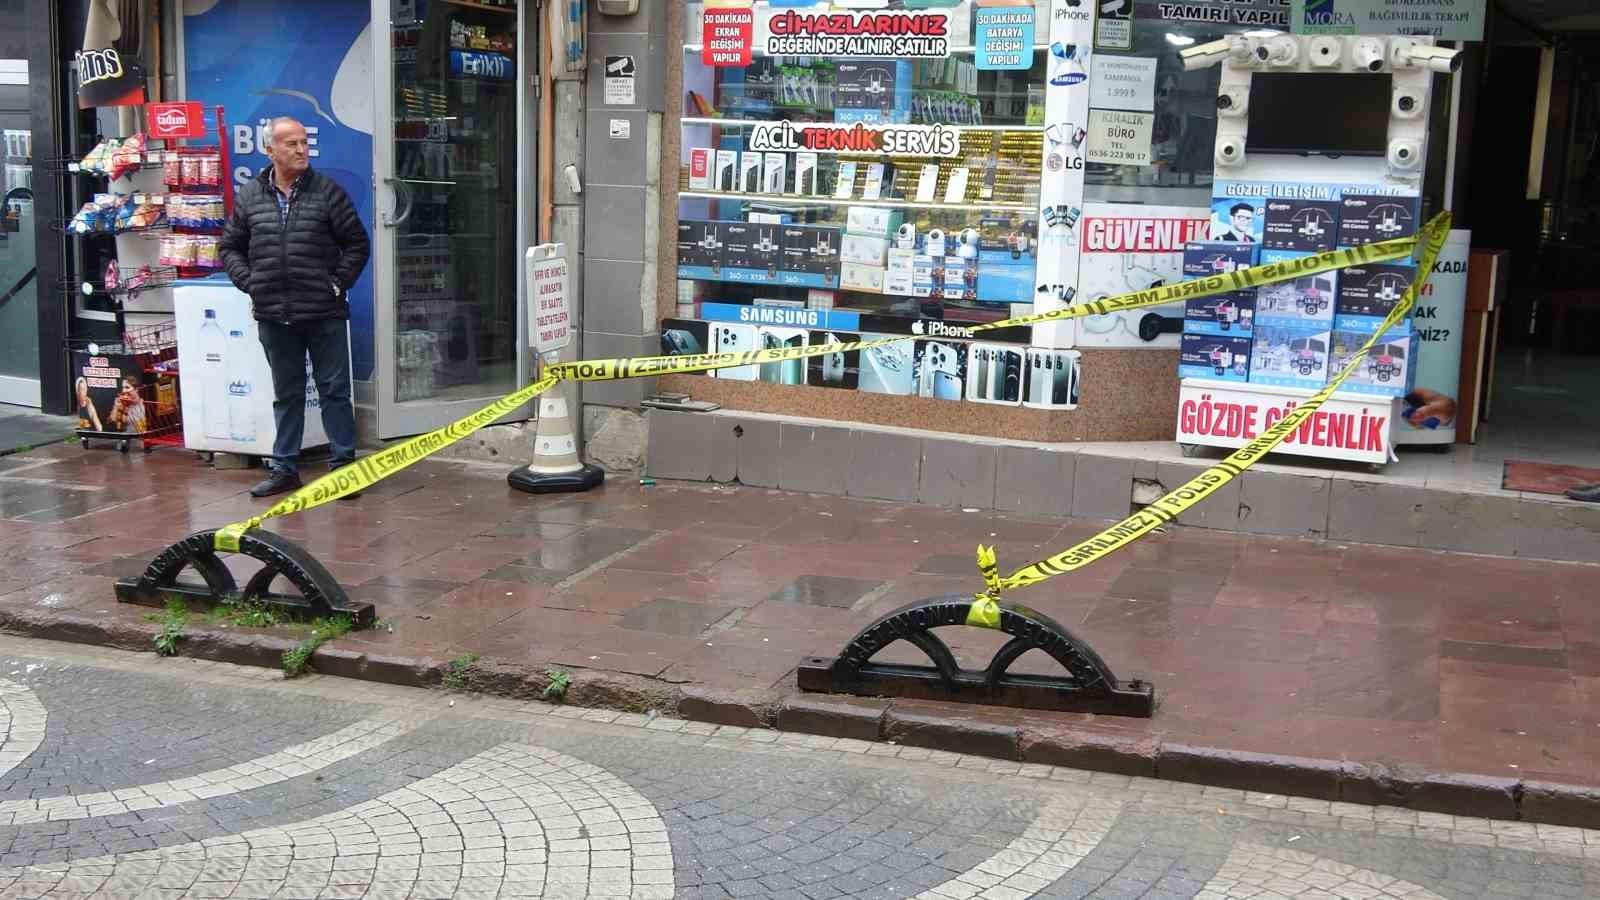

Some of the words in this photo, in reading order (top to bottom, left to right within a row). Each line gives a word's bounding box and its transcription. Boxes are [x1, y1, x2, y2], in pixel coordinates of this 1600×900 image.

[704, 14, 714, 24] 30
[715, 12, 752, 24] DAKİKADA
[977, 15, 989, 24] 30
[991, 12, 1032, 24] DAKİKADA
[1055, 8, 1089, 20] iPhone
[1303, 12, 1356, 26] MORA
[1369, 11, 1432, 21] BAĞIMLILIK
[1435, 11, 1469, 22] TERAPİ
[769, 10, 948, 35] CİHAZLARINIZ
[715, 27, 740, 37] EKRAN
[986, 27, 1024, 38] BATARYA
[710, 38, 744, 50] DEĞİŞİMİ
[769, 35, 846, 55] DEĞERİNDE
[846, 37, 894, 56] ALINIR
[894, 37, 947, 56] SATILIR
[985, 39, 1024, 54] DEĞİŞİMİ
[461, 52, 504, 77] Erikli
[713, 52, 741, 63] YAPILIR
[987, 55, 1020, 65] YAPILIR
[233, 118, 319, 156] BÜE
[754, 121, 798, 149] ACİL
[802, 123, 877, 151] TEKNİK
[881, 124, 956, 155] SERVİS
[1107, 124, 1135, 139] BÜRO
[1065, 156, 1082, 170] LG
[1227, 182, 1268, 197] GÖZDE
[1271, 182, 1329, 199] İLETİŞİM
[1087, 219, 1212, 250] GÜVENLİK
[739, 306, 818, 327] SAMSUNG
[928, 321, 975, 338] iPhone
[635, 353, 735, 374] GİRİLMEZ
[1180, 394, 1258, 440] GÖZDE
[1265, 402, 1387, 452] GÜVENLİK
[1060, 514, 1155, 568] GİRİLMEZ
[1166, 472, 1222, 508] POLİS
[1236, 409, 1308, 463] GİRİLMEZ
